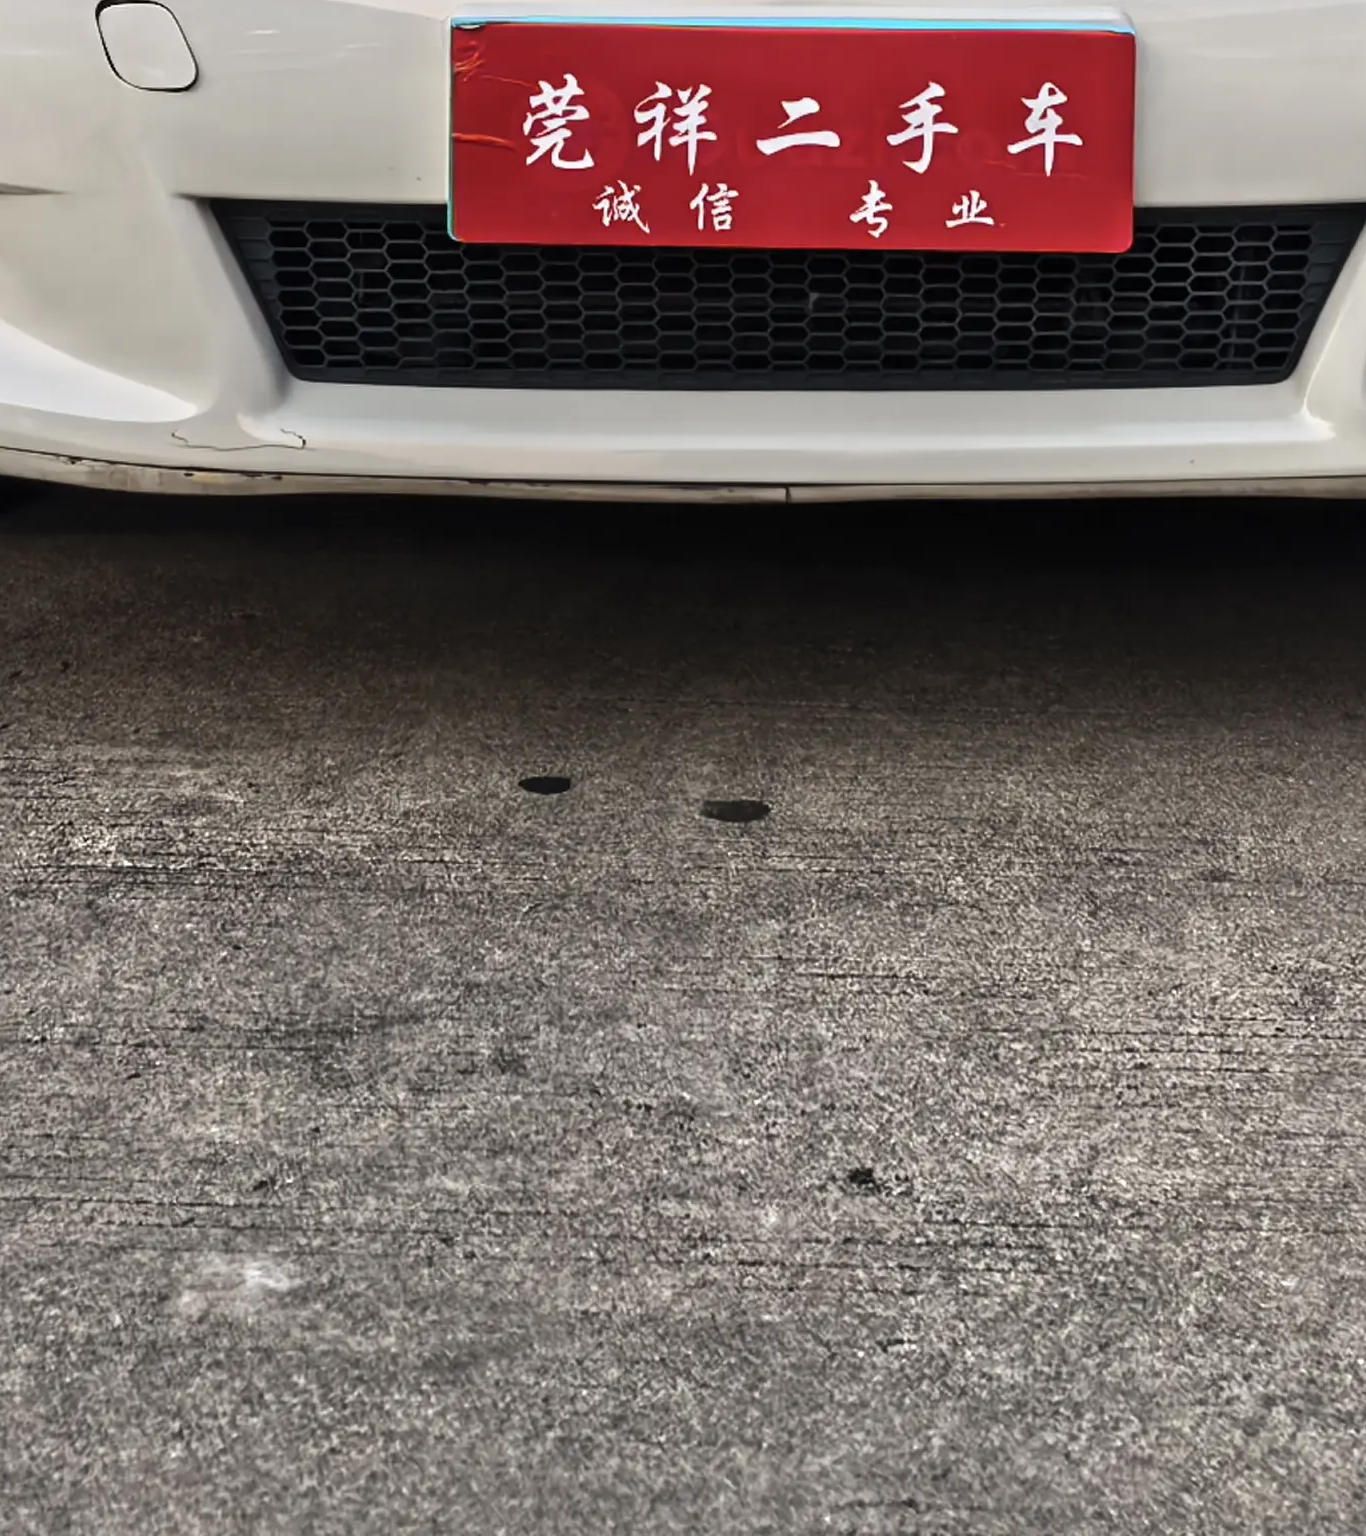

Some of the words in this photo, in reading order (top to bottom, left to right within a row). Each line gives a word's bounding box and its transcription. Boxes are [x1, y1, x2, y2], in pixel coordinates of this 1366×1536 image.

[521, 73, 1084, 177] 莞祥二手车
[592, 180, 740, 234] 诚信
[849, 179, 997, 238] 专业
